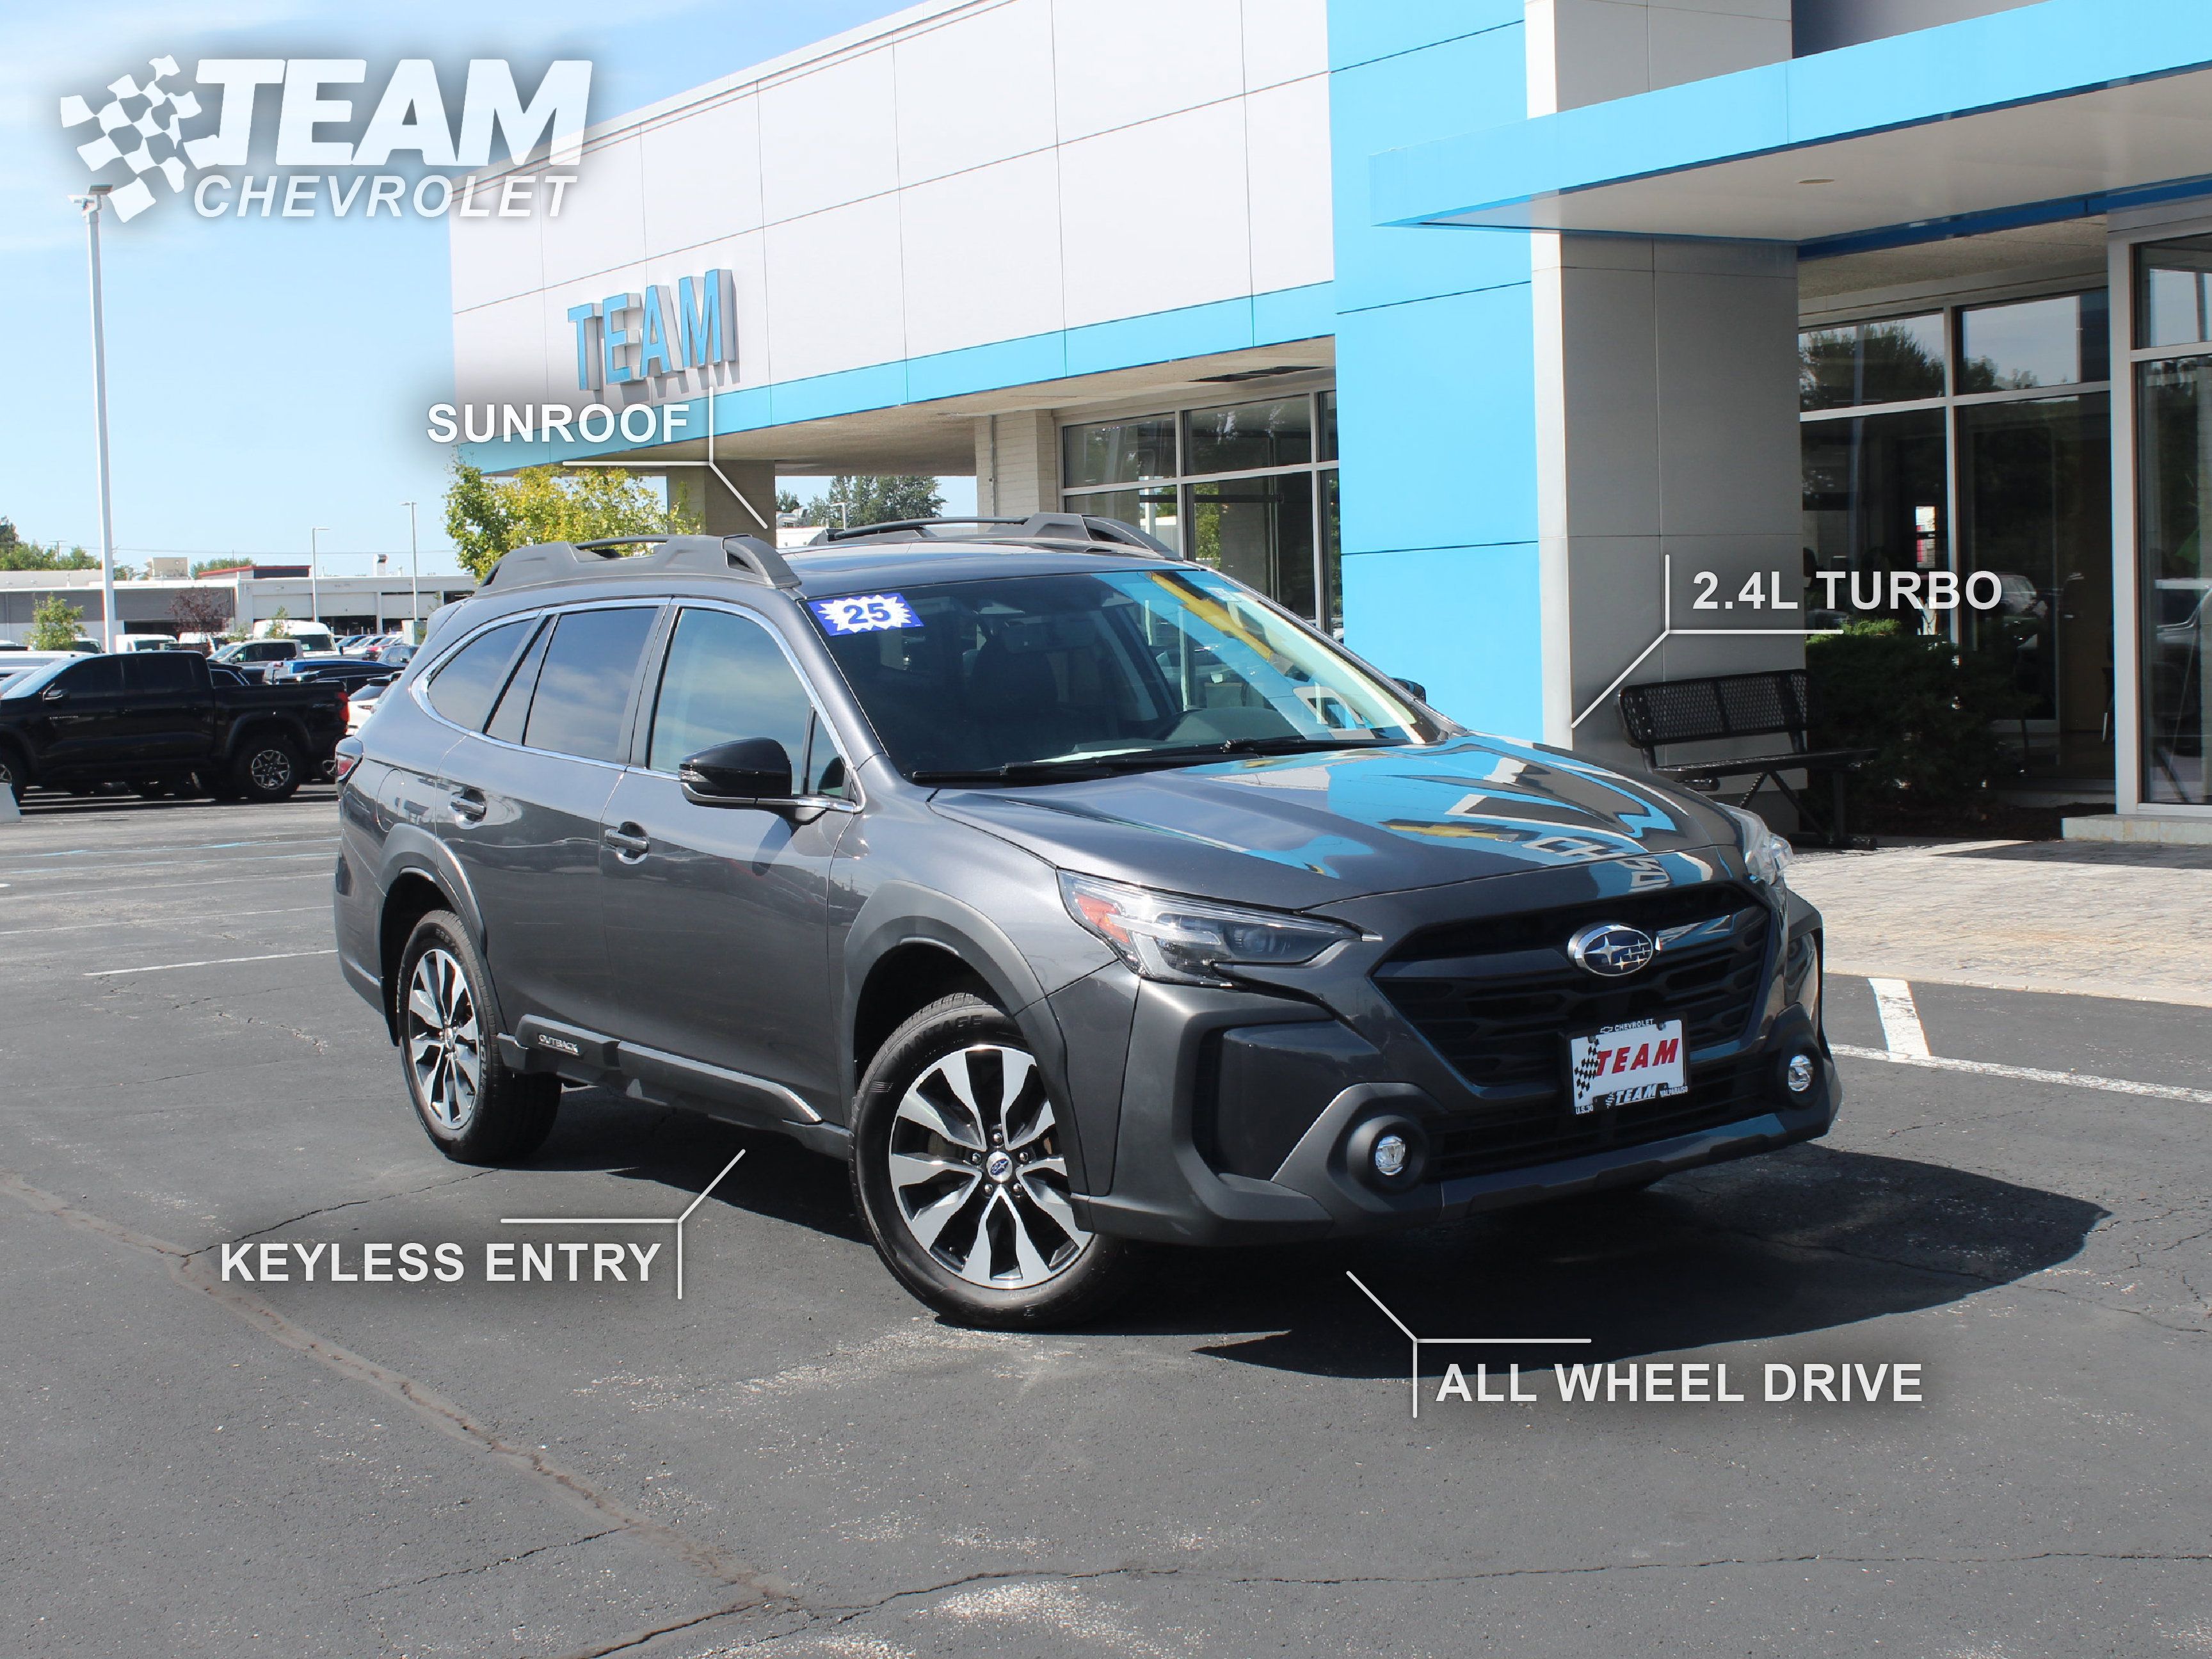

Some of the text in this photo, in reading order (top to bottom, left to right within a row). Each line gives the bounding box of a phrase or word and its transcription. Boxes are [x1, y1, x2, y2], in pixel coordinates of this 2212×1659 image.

[568, 269, 735, 390] TEAM
[843, 602, 891, 625] 25
[1614, 1018, 1654, 1032] CHEVROLET
[1596, 1038, 1679, 1077] TEAM
[1615, 1084, 1657, 1106] TEAM
